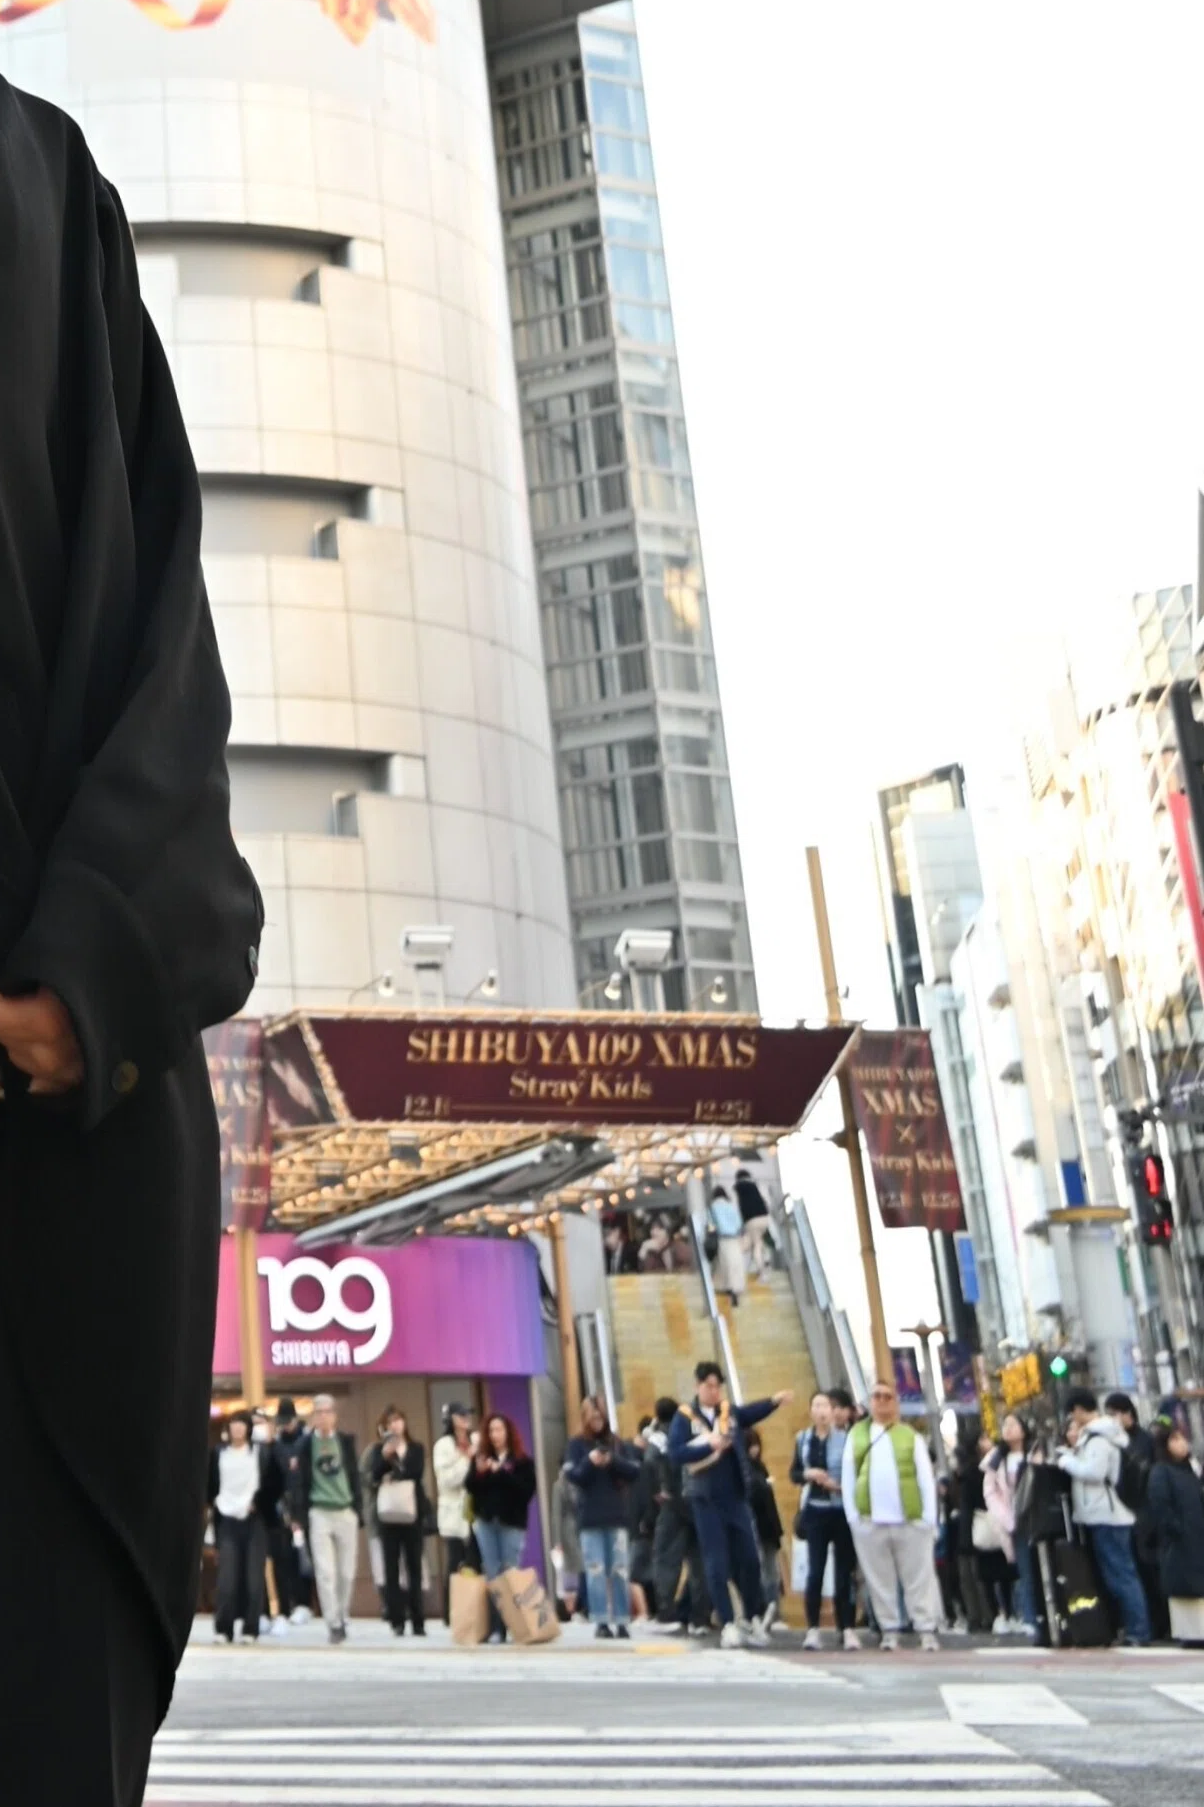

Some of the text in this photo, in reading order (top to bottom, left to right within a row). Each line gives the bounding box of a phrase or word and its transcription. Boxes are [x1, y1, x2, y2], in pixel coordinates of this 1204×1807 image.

[406, 1028, 757, 1068] SHIBUYA109 XMAS
[509, 1068, 653, 1106] Stray Kids
[862, 1088, 939, 1116] XMAS
[257, 1256, 393, 1365] 109
[271, 1339, 351, 1366] SHIBUYA
